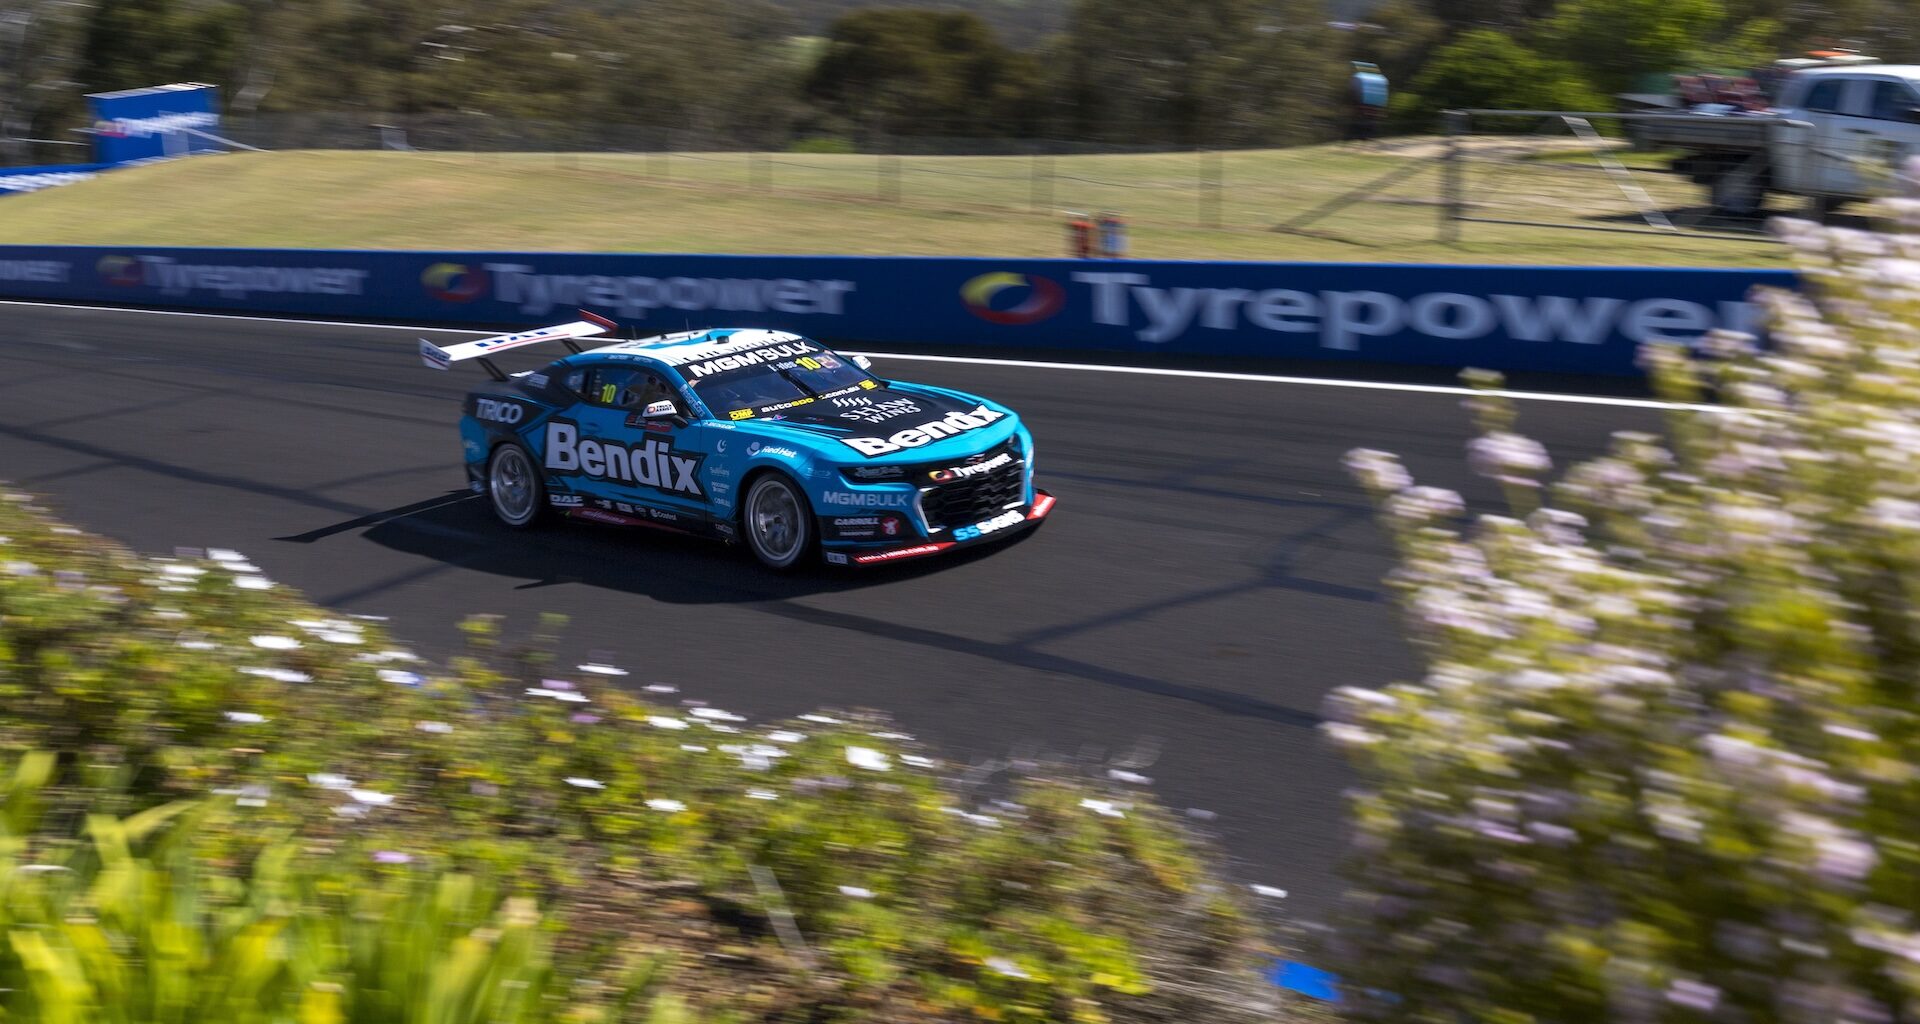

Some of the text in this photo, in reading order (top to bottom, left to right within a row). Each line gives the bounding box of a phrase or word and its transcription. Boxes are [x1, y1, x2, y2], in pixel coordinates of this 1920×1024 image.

[484, 262, 856, 320] Tyrepower
[688, 341, 818, 378] MGMBULK
[795, 356, 821, 371] 10
[601, 384, 616, 404] 10
[476, 398, 523, 424] TRICO
[730, 409, 754, 420] OMP
[840, 397, 915, 421] SHAW
[864, 405, 922, 424] WINES
[841, 405, 1004, 456] Bendix
[545, 421, 702, 495] Bendix
[550, 494, 583, 503] DAF
[823, 490, 907, 507] MGMBULK
[834, 517, 880, 526] CARROLL
